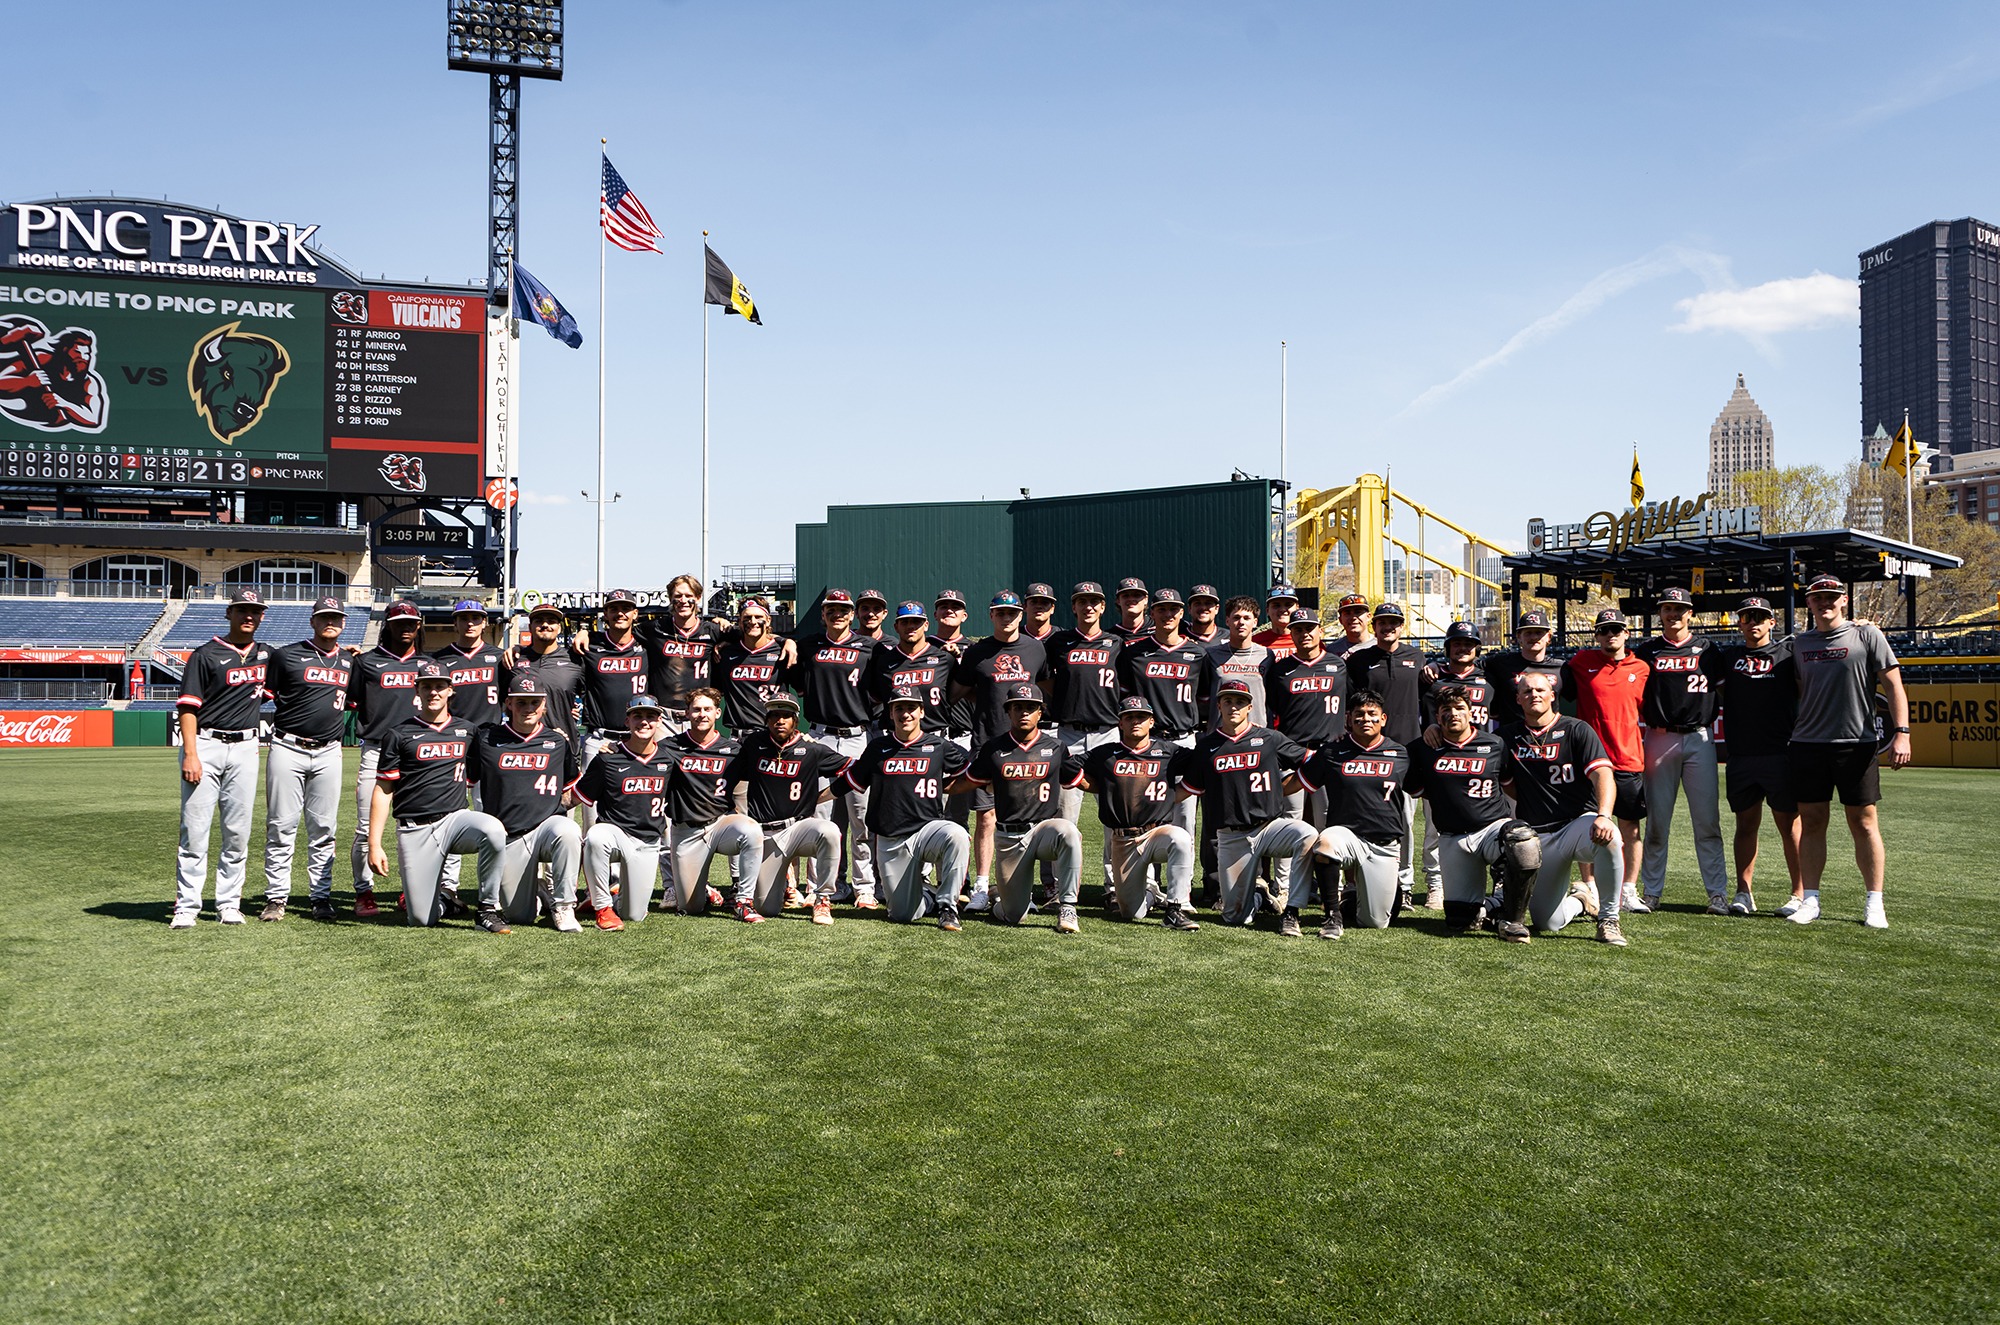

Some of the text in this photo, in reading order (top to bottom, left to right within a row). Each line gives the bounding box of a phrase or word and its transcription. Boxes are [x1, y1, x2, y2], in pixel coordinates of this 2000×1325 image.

[10, 203, 321, 266] PNC PARK
[1977, 227, 2000, 247] UPM
[18, 252, 317, 284] HOME OF THE PITTSBURGH PIRATES
[1861, 248, 1893, 272] UPMC
[115, 292, 151, 310] TO
[157, 295, 217, 314] PNC
[221, 299, 296, 319] PARK
[387, 295, 466, 308] CALIFORNIA (PA)
[392, 303, 462, 329] VULCANS
[337, 329, 401, 340] 21 RF ARRIGO
[335, 340, 407, 351] 42 LF MINERVA
[336, 350, 397, 362] 14 CF EVANS
[497, 341, 507, 372] EAT
[335, 361, 389, 372] 40 DH HESS
[120, 366, 169, 386] VS
[337, 372, 417, 384] 4 1B PATTERSON
[335, 384, 402, 394] 27 3B CARNEY
[335, 394, 392, 405] 28 C RIZZO
[337, 405, 402, 416] 8 SS COLLINS
[337, 415, 389, 427] 6 2B FORD
[8, 452, 188, 468] 0 0 2 0 0 0 0 2 12 3 12
[276, 452, 300, 460] PITCH
[8, 466, 185, 482] 5 0 0 0 2 0 X 7 6 2 8
[193, 462, 246, 481] 2 1 3
[265, 468, 324, 480] PNC PARK
[1552, 522, 1591, 548] IT'S
[1584, 491, 1717, 554] Miller
[1698, 507, 1761, 536] TIME
[386, 530, 463, 542] 3:05 PM 72°
[592, 592, 670, 608] HD'S
[600, 660, 640, 671] CAL U
[1069, 651, 1107, 663] CAL U
[452, 669, 493, 684] CAL U
[694, 660, 708, 679] 14
[848, 668, 859, 686] 4
[994, 673, 1030, 682] VULCANS
[1098, 668, 1115, 688] 12
[1148, 664, 1187, 677] CAL U
[1222, 665, 1265, 675] VULCANS
[631, 675, 647, 694] 19
[1687, 674, 1708, 693] 22
[487, 686, 498, 704] 5
[930, 687, 941, 705] 9
[1176, 683, 1192, 703] 10
[1323, 695, 1340, 714] 18
[1908, 700, 2000, 723] EDGAR S
[0, 715, 78, 743] oca-Cola
[1949, 725, 1959, 741] &
[502, 755, 547, 768] CAL U
[682, 759, 724, 772] CAL U
[885, 760, 928, 772] CAL U
[1115, 762, 1158, 775] CAL U
[1216, 754, 1258, 771] CAL U
[1344, 762, 1390, 775] CAL U
[1436, 759, 1483, 772] CAL U
[1003, 765, 1048, 777] CAL U
[1550, 763, 1574, 785] 20
[534, 774, 557, 796] 44
[714, 778, 726, 797] 2
[789, 781, 801, 800] 8
[914, 778, 938, 798] 46
[1250, 771, 1271, 793] 21
[1468, 778, 1492, 798] 28
[1038, 782, 1050, 802] 6
[1144, 781, 1167, 801] 42
[1383, 781, 1397, 801] 7
